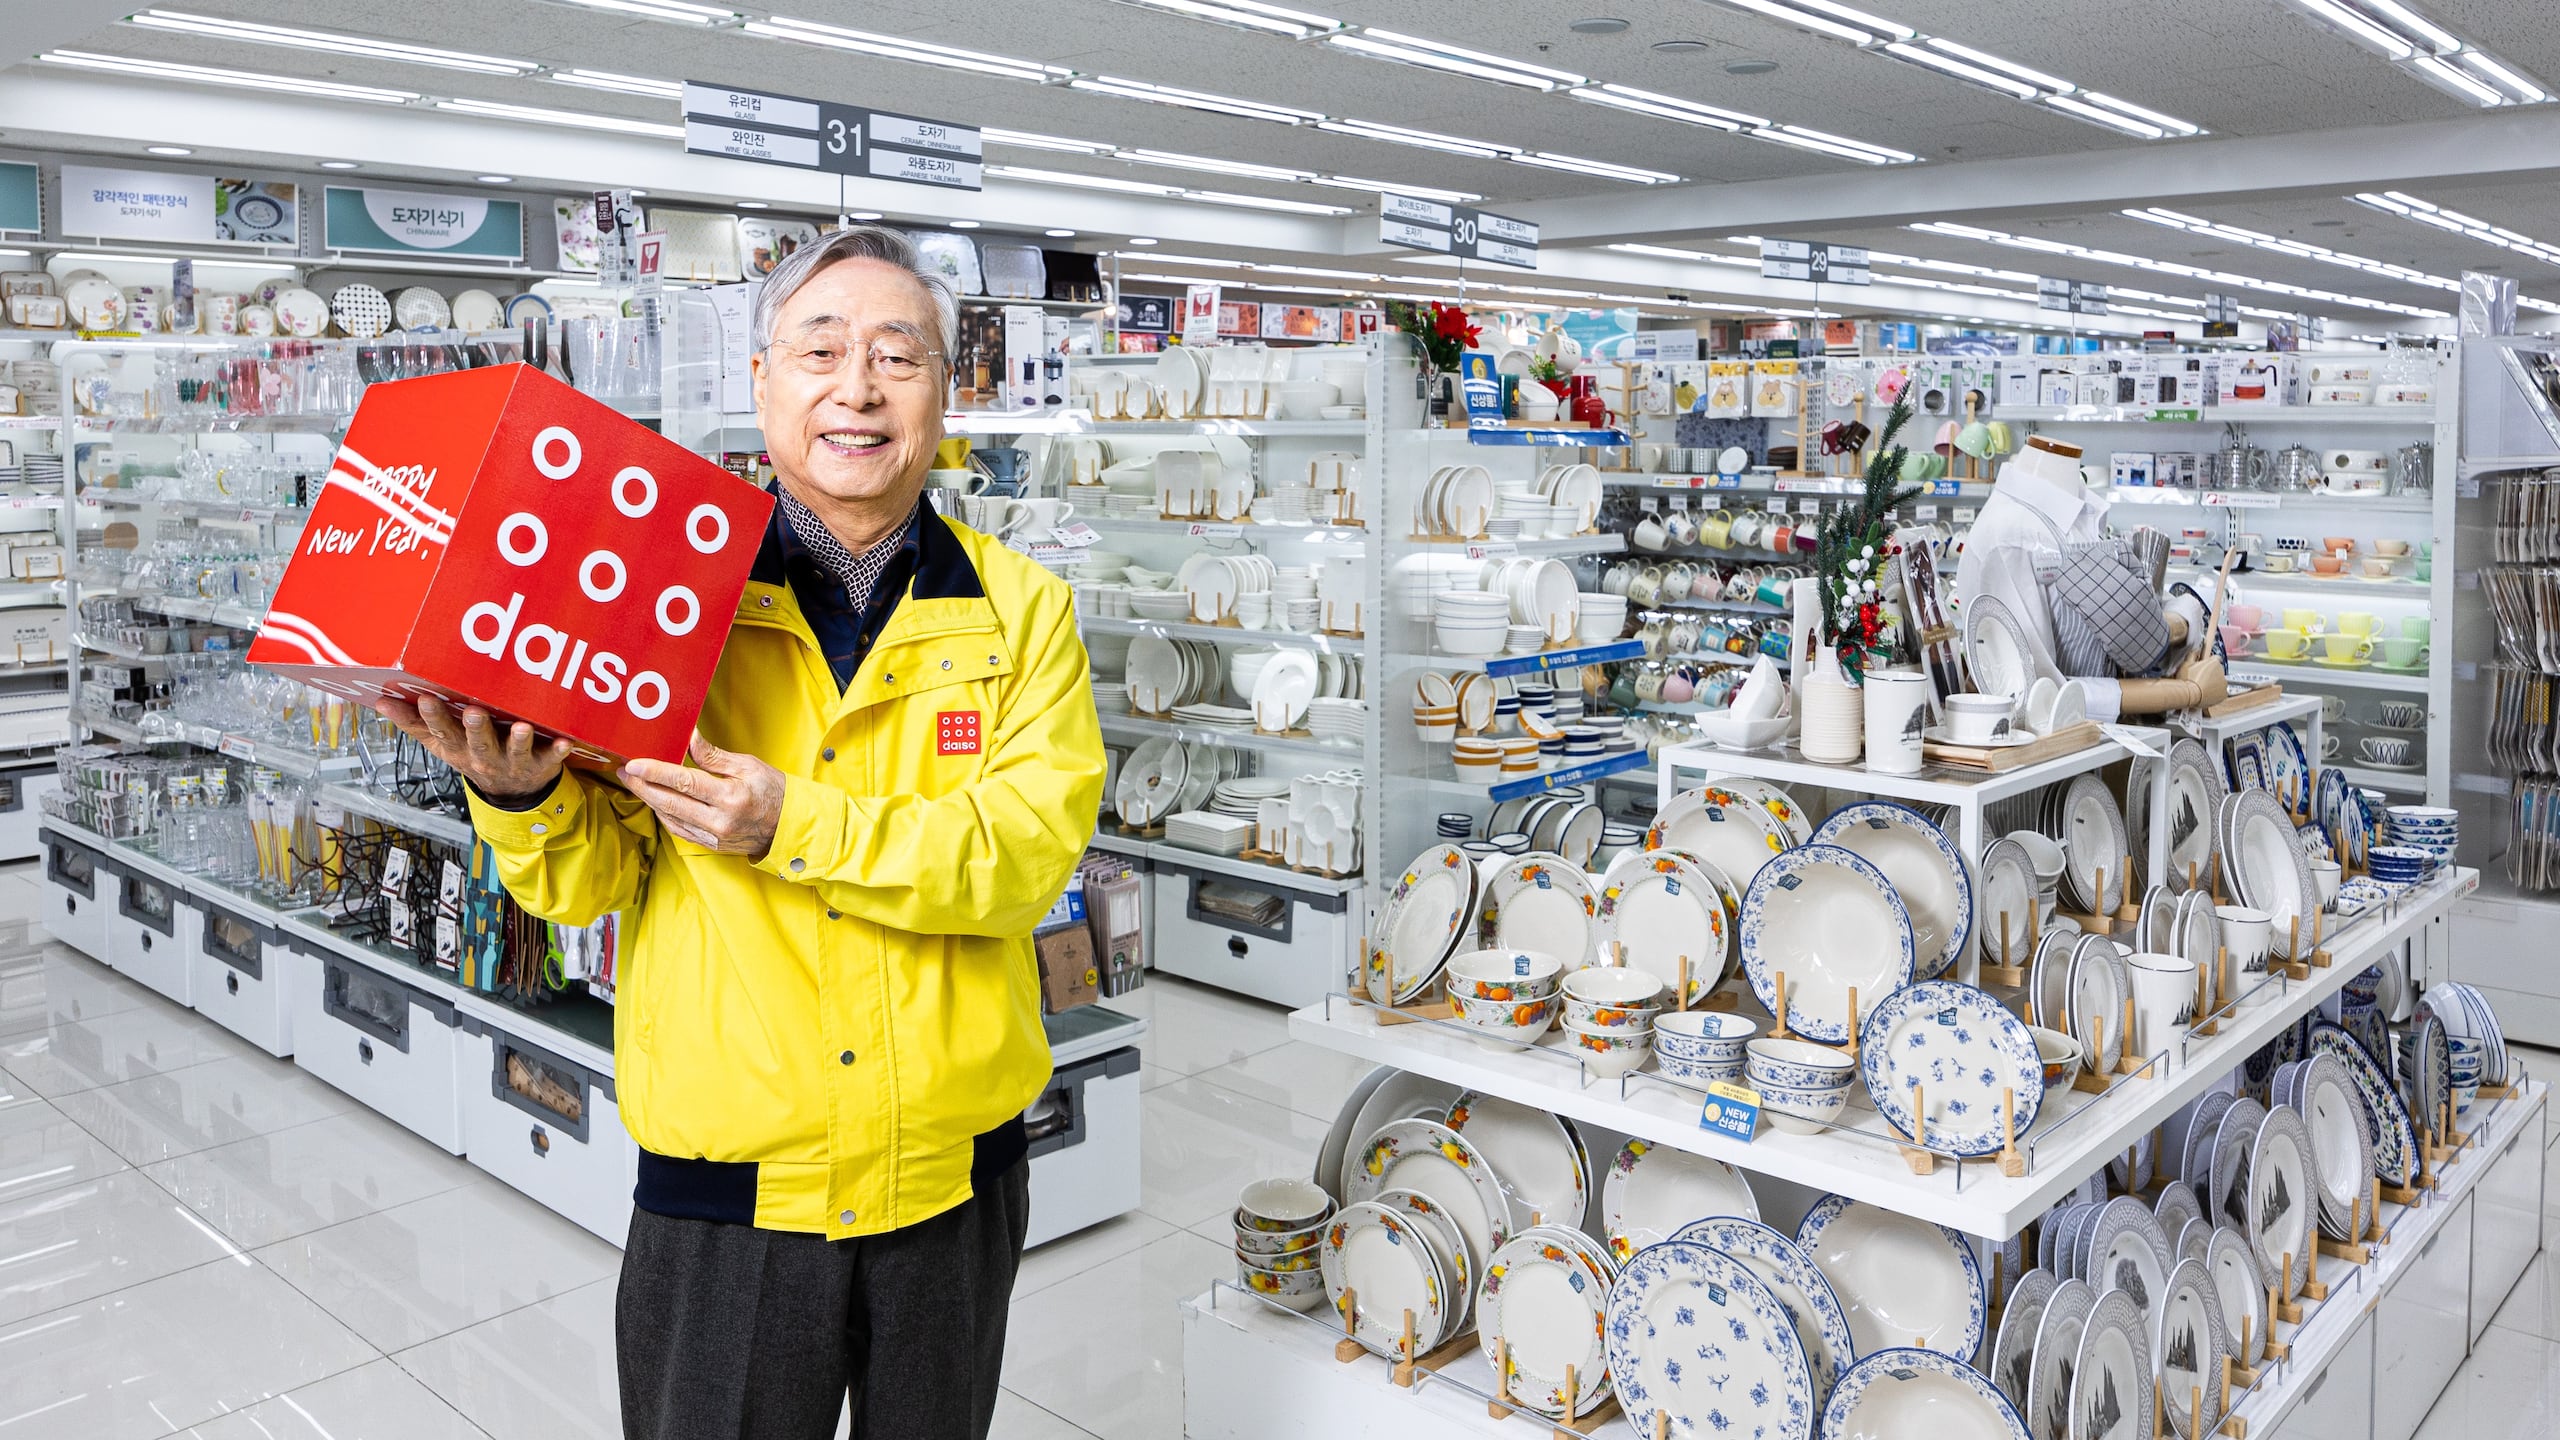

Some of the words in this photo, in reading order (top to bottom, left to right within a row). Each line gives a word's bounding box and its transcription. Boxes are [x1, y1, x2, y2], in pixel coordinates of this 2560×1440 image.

[729, 94, 762, 111] 유리컵
[734, 111, 757, 121] GLASS
[732, 130, 766, 147] 와인잔
[826, 119, 862, 157] 31
[900, 136, 926, 147] CERAMIC
[918, 125, 946, 141] 도자기
[725, 145, 741, 154] WINE
[742, 148, 772, 159] GLASSES
[900, 169, 929, 180] JAPANESE
[93, 189, 140, 205] 감각적인
[142, 193, 188, 209] 패턴장식
[120, 206, 145, 218] 도자기
[146, 208, 161, 218] 식기
[391, 206, 435, 227] 도자기
[437, 209, 464, 229] 식기
[405, 227, 450, 238] CHINAWARE
[1453, 217, 1477, 245] 30
[1811, 250, 1827, 273] 29
[2070, 286, 2081, 305] 28
[1471, 393, 1498, 408] 신상품!
[306, 524, 364, 556] New
[460, 592, 671, 721] daiso
[942, 740, 977, 751] daiso
[1725, 1106, 1750, 1122] NEW
[1718, 1116, 1751, 1135] 신상품!
